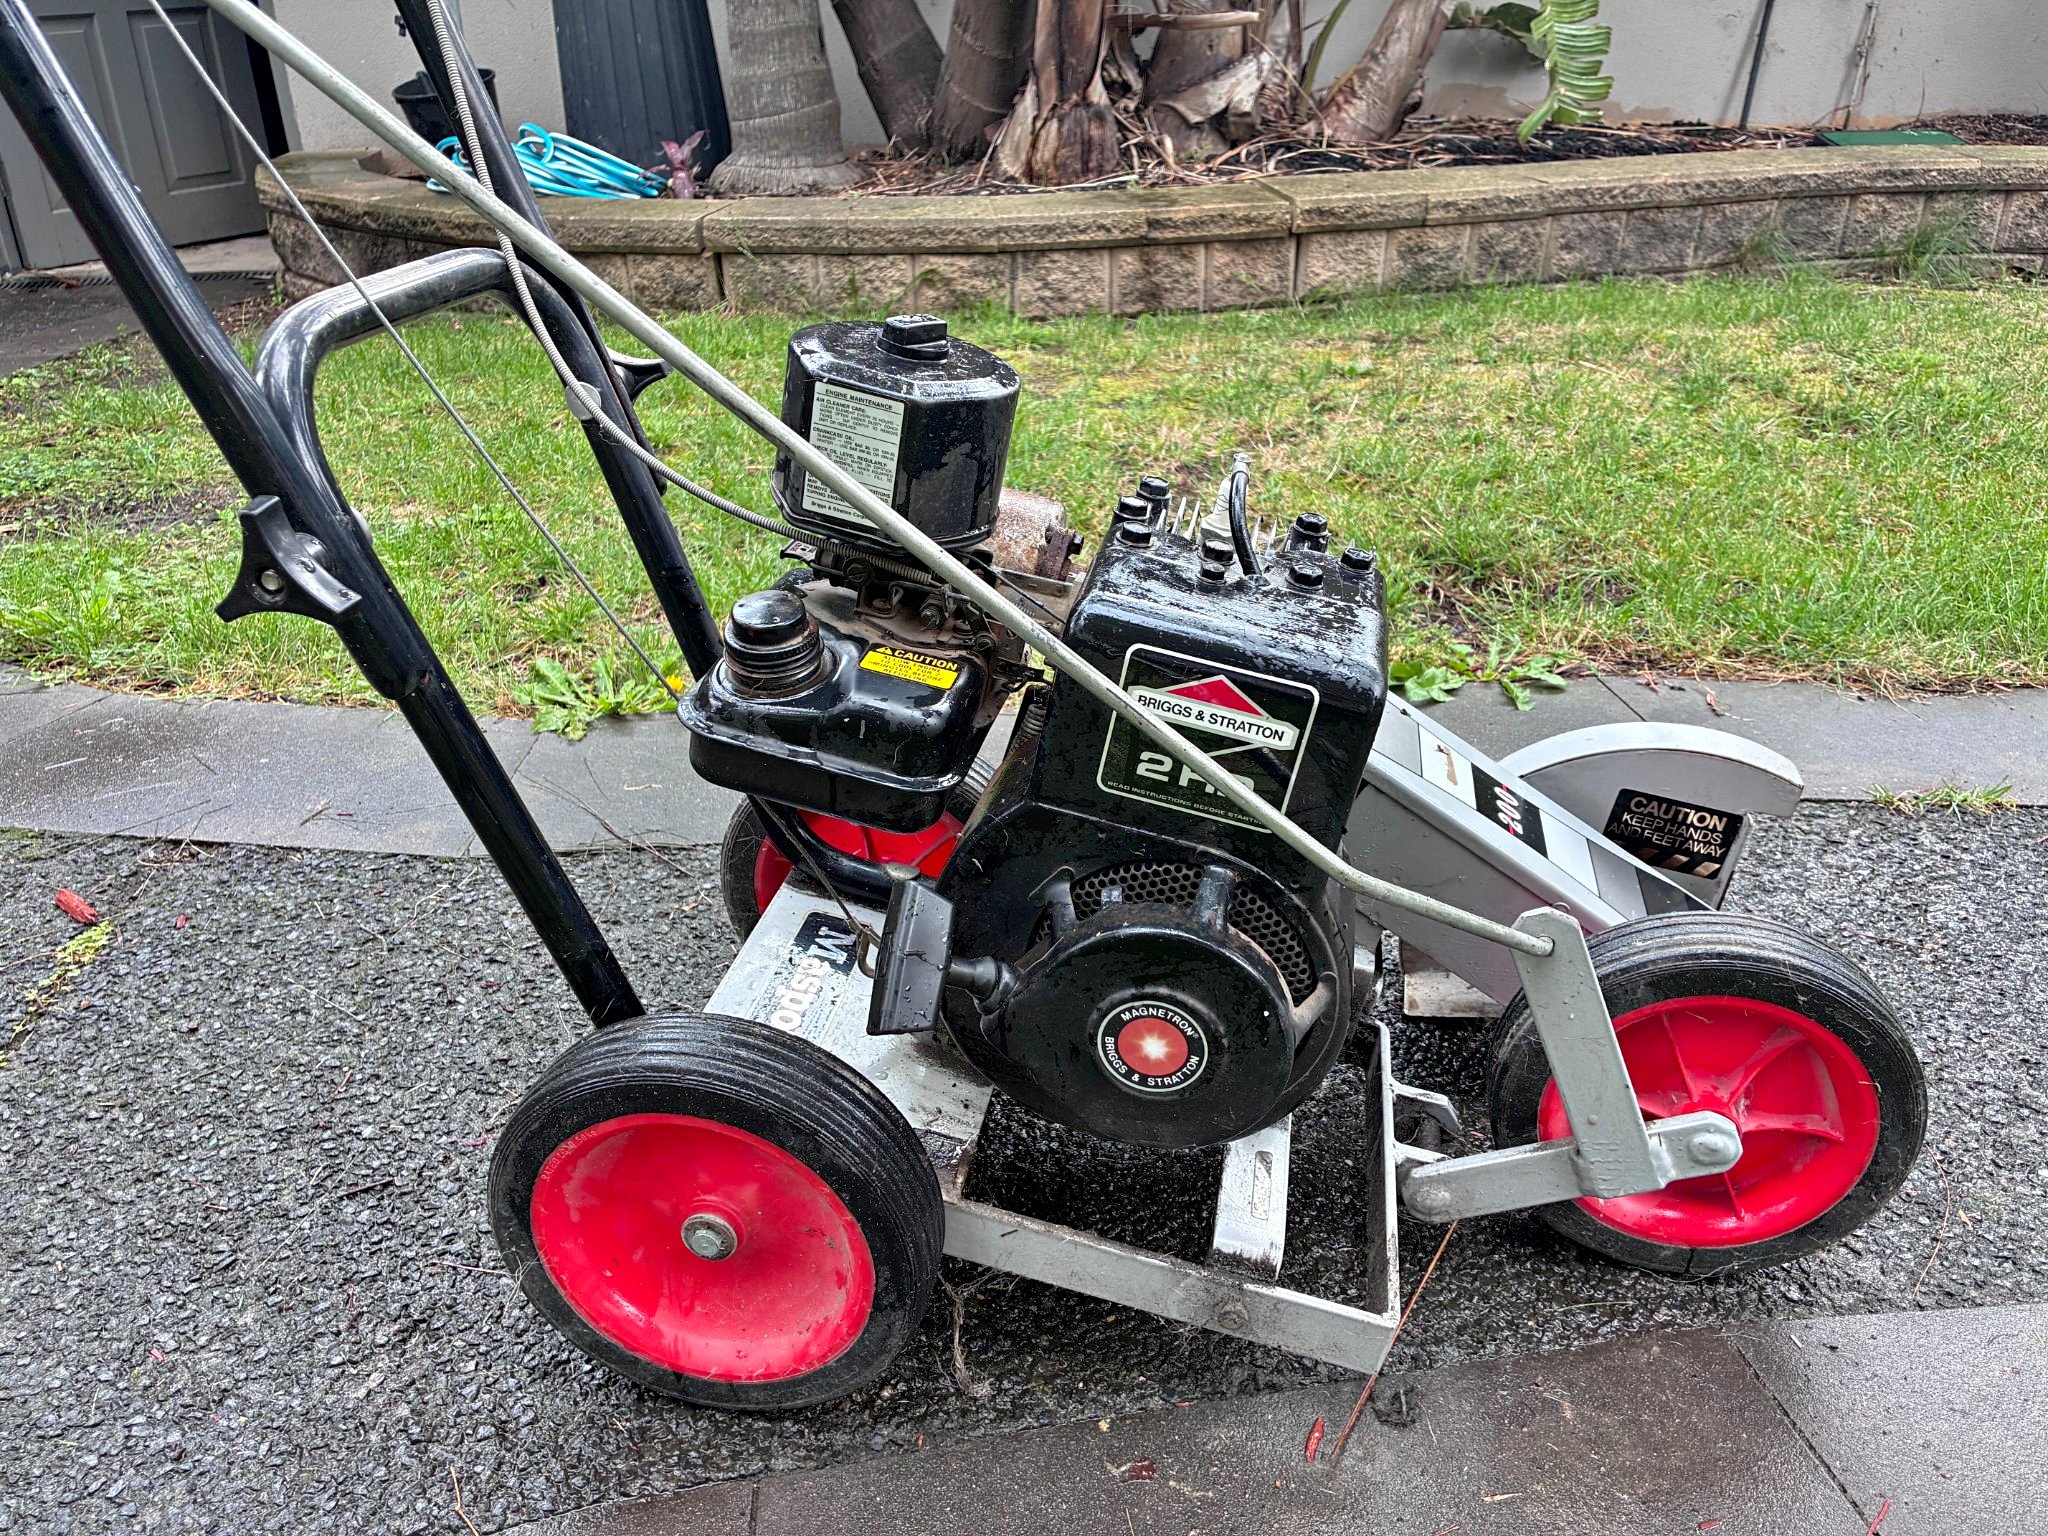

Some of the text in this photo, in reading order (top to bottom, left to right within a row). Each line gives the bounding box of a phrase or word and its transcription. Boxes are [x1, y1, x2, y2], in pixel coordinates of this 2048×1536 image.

[826, 389, 893, 410] ENGINE MAINTENANCE
[826, 399, 850, 409] CLEANER
[836, 406, 855, 414] ELEMENT
[813, 427, 843, 438] CRANKCASE
[880, 428, 898, 436] REMOVE
[840, 451, 855, 459] LEVEL
[872, 470, 893, 478] EQUIPPED
[807, 483, 828, 492] REMOVE
[807, 489, 826, 497] TIPPING
[811, 501, 826, 509] Briggs
[833, 507, 851, 515] Stratton
[883, 655, 941, 672] ALLOW ENGINE
[893, 662, 913, 670] COOL
[917, 667, 932, 675] FOR
[895, 650, 958, 670] CAUTION
[873, 661, 943, 681] MINUTES BEFORE
[883, 668, 928, 683] REFUELING
[1137, 695, 1284, 741] BRIGGS & STRATTON
[1136, 751, 1173, 782] 2
[1108, 780, 1130, 791] READ
[1131, 787, 1192, 807] INSTRUCTIONS
[1193, 803, 1226, 816] BEFORE
[1494, 787, 1523, 835] 200
[1630, 796, 1727, 832] CAUTION
[1622, 811, 1723, 845] KEEP HANDS
[1608, 822, 1726, 858] AND FEET AWAY
[770, 925, 857, 1031] Maspo
[1121, 1007, 1195, 1036] MAGNETRON
[1105, 1036, 1200, 1086] BRIGGS & STRATTON
[541, 1158, 560, 1182] RATED
